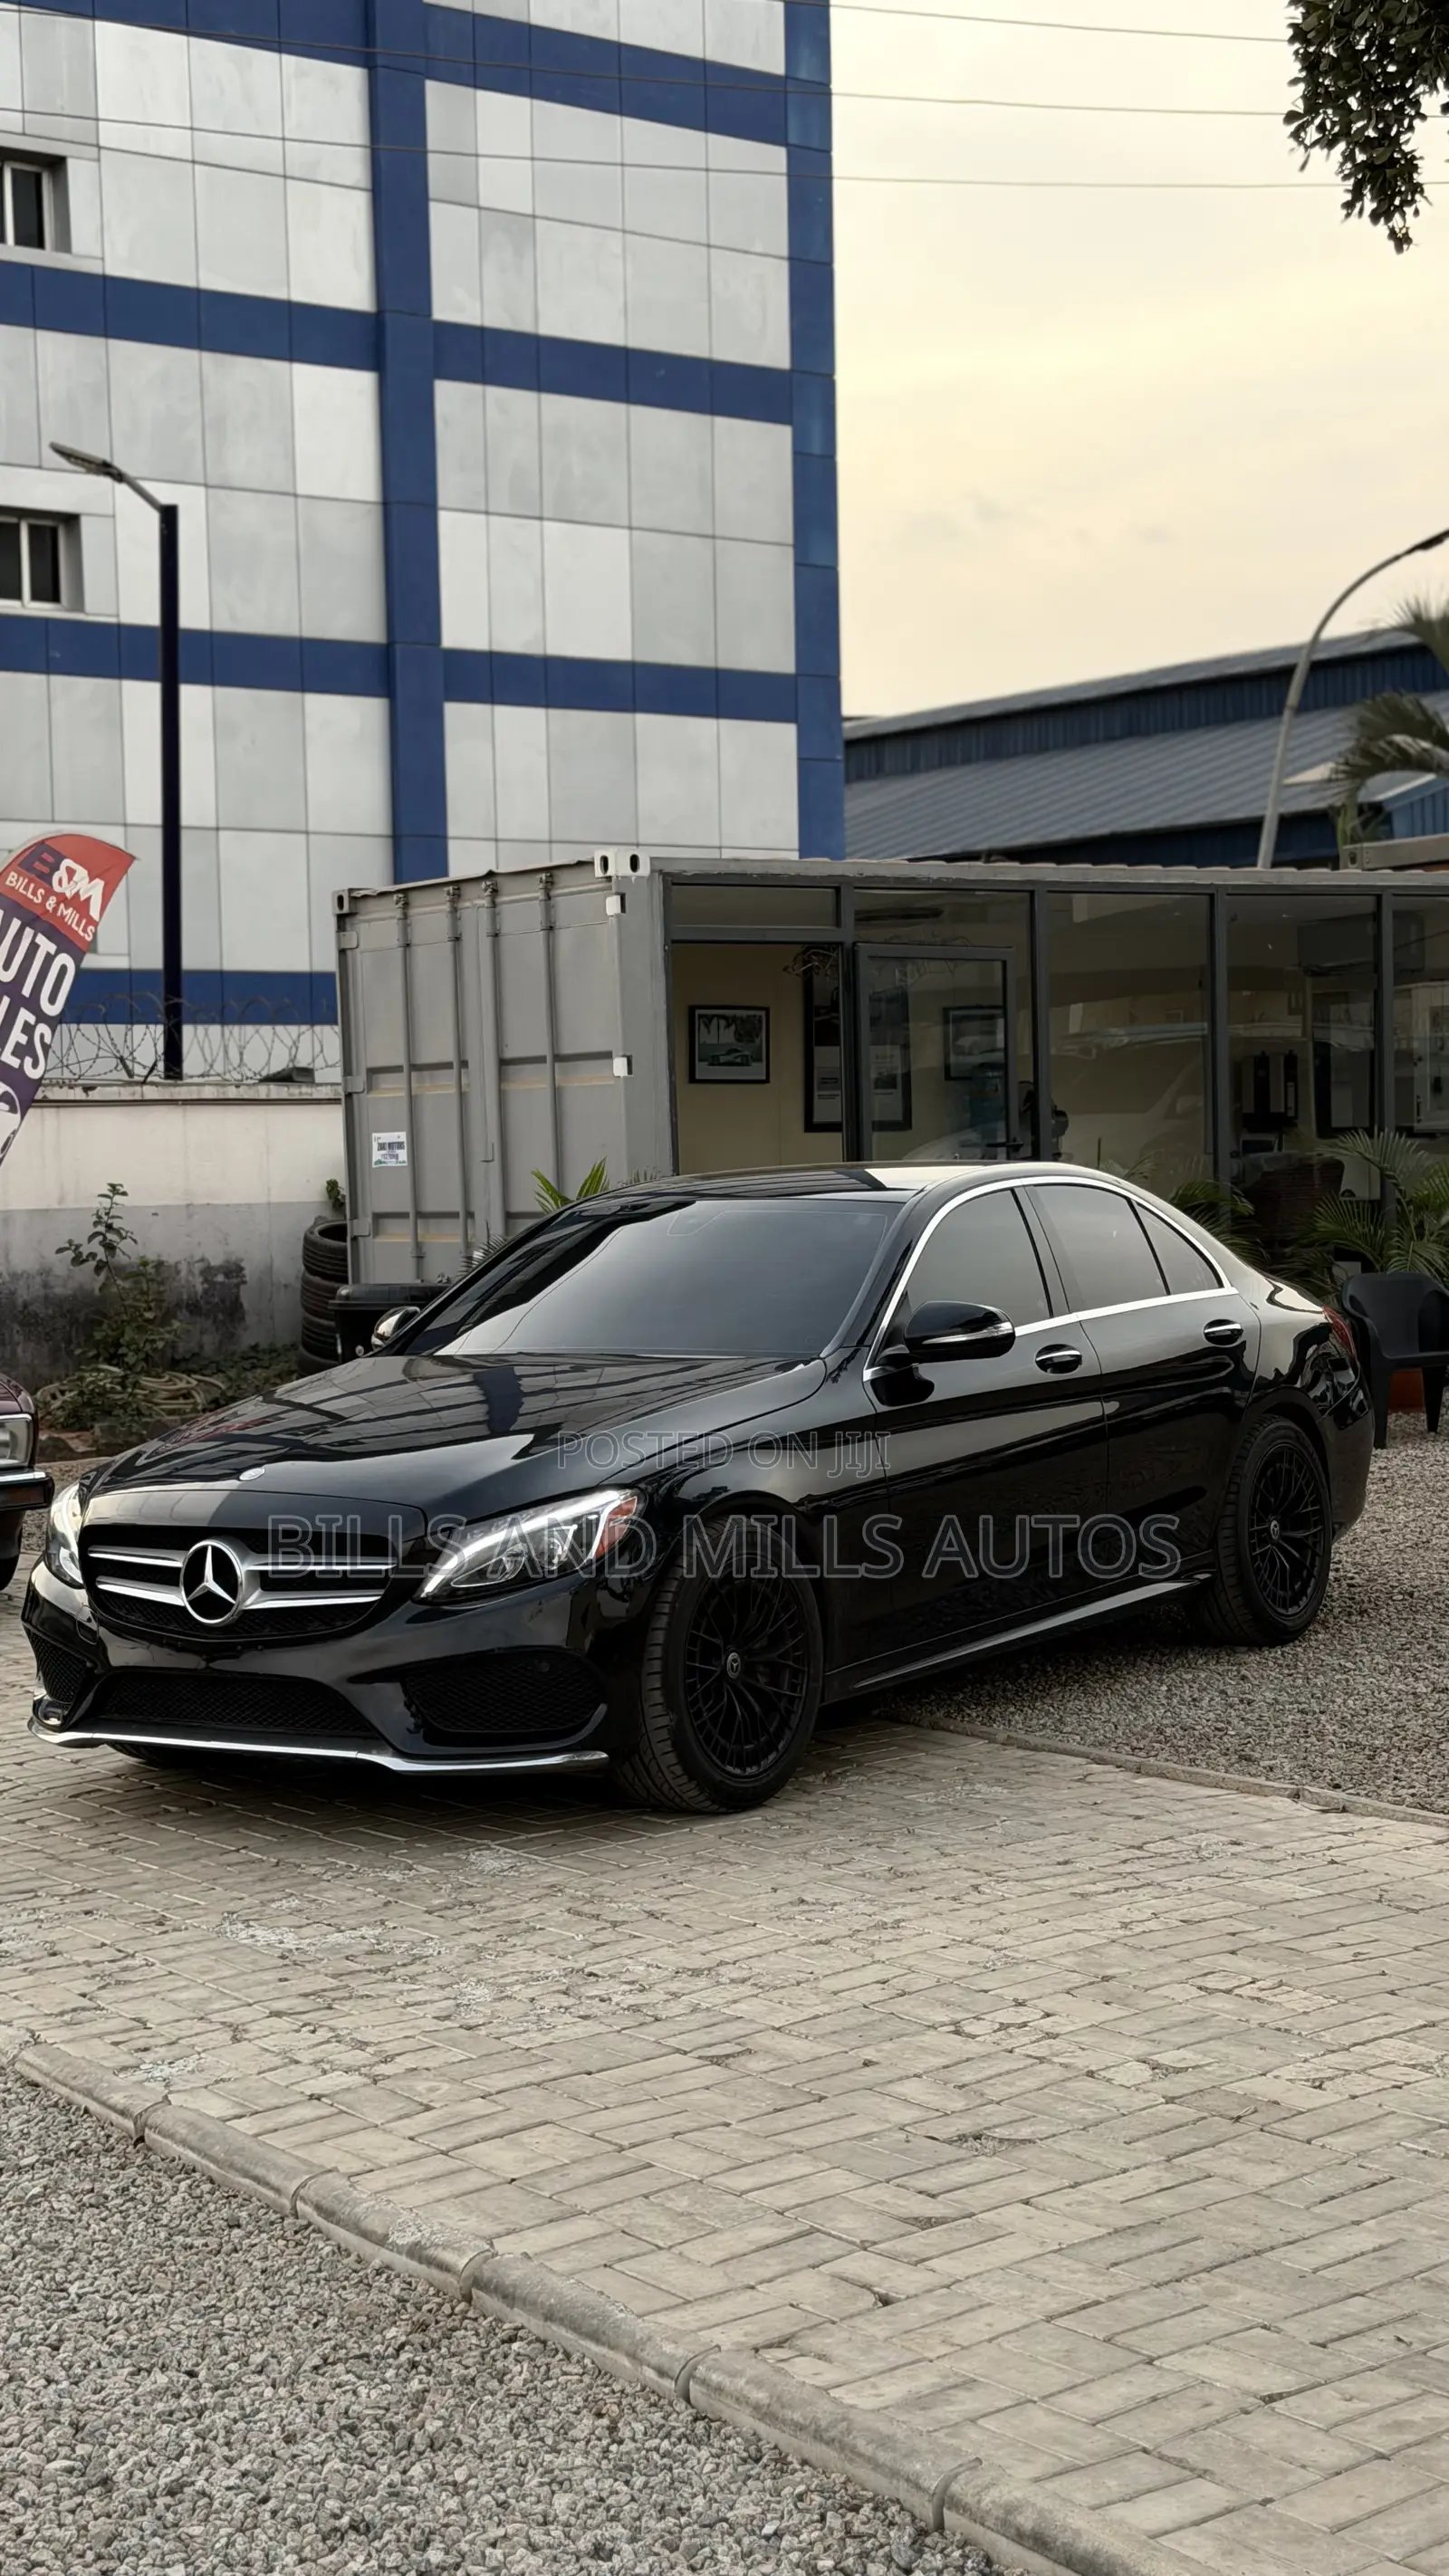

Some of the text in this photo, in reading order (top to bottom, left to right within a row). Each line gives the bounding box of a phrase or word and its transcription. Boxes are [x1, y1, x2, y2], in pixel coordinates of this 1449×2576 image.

[5, 871, 95, 942] BILLS & MILLS
[0, 908, 76, 1017] UTO
